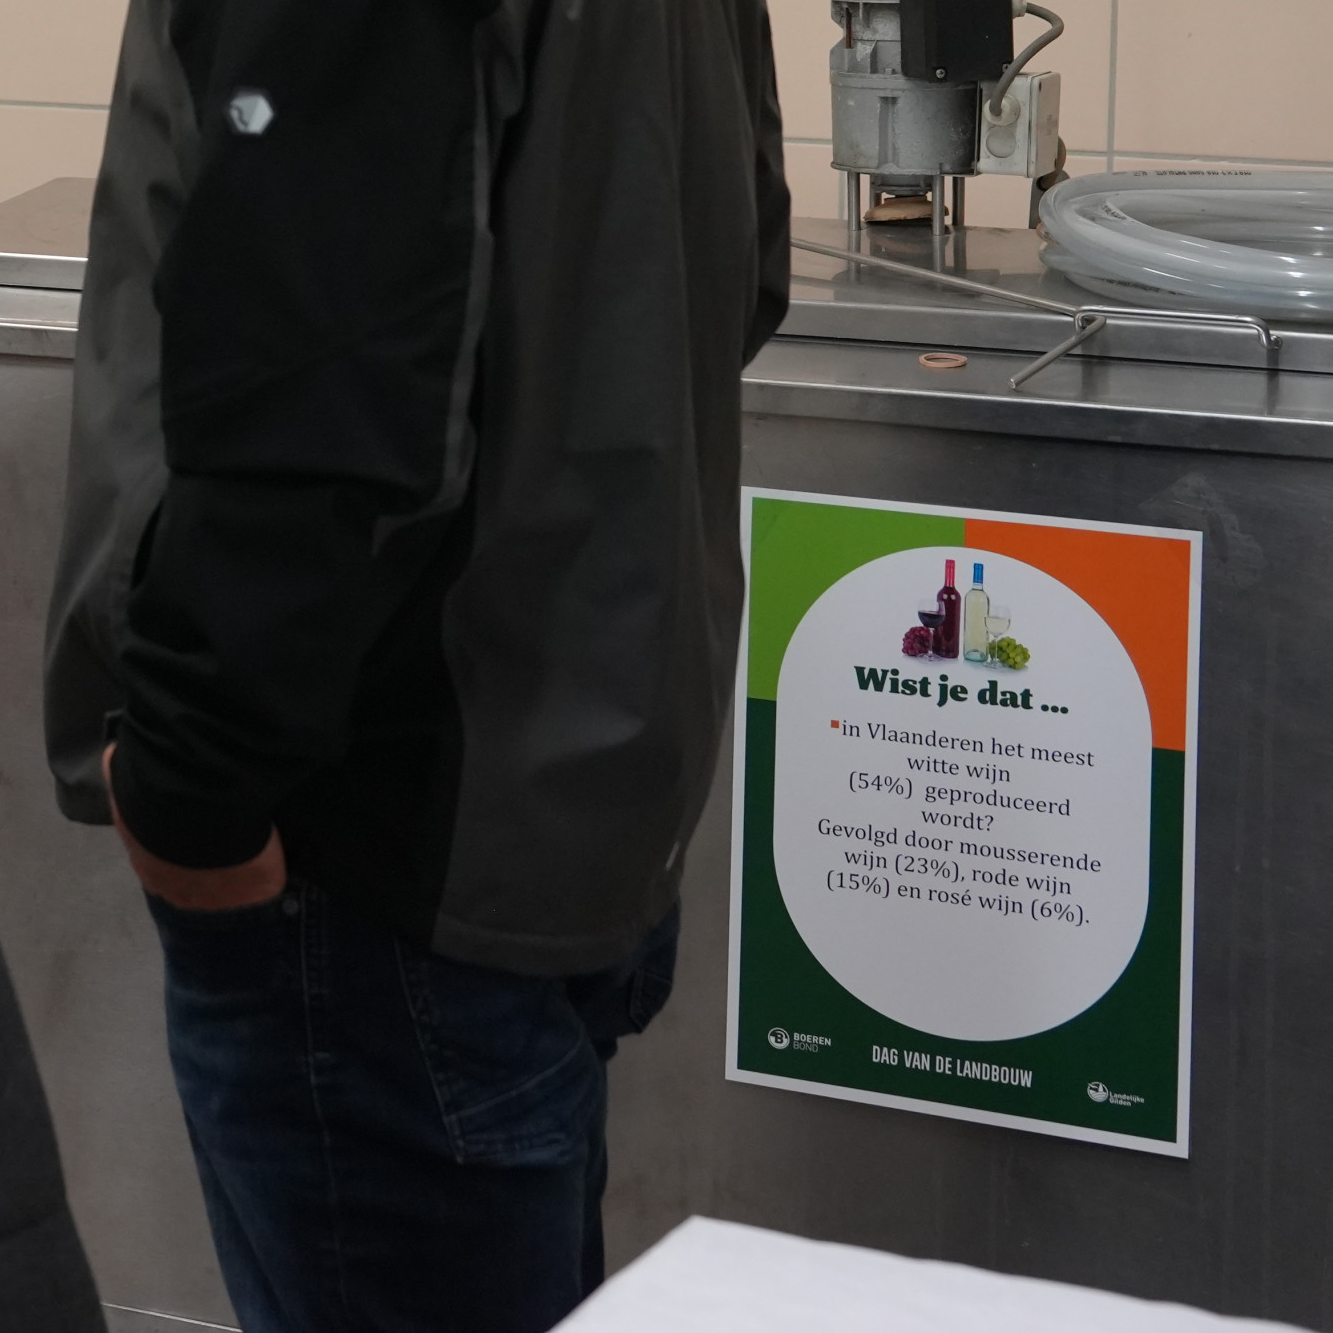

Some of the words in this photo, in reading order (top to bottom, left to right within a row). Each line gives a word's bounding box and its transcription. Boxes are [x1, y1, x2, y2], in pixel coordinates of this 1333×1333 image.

[854, 666, 932, 698] Wist
[936, 674, 969, 707] je
[977, 680, 1033, 709] dat
[842, 720, 860, 737] in
[867, 723, 984, 753] Vlaanderen
[991, 738, 1024, 758] het
[1031, 746, 1094, 766] meest
[907, 756, 959, 775] witte
[966, 764, 1010, 784] wijn
[849, 771, 913, 799] (54%)
[925, 785, 1070, 816] geproduceerd
[921, 810, 994, 831] wordt?
[818, 818, 898, 847] Gevolgd
[905, 830, 953, 852] door
[960, 840, 1101, 872] mousserende
[844, 850, 887, 870] wijn
[895, 854, 965, 883] (23%),
[972, 869, 1019, 887] rode
[1026, 875, 1071, 897] wijn
[827, 870, 890, 899] (15%)
[897, 884, 921, 900] en
[928, 889, 972, 907] rosé
[978, 895, 1023, 916] wijn
[1030, 899, 1090, 927] (6%).
[793, 1032, 831, 1047] BOEREN
[793, 1041, 819, 1053] BOND
[872, 1045, 898, 1066] DAG
[903, 1050, 930, 1071] VAN
[935, 1055, 952, 1075] DE
[957, 1059, 1032, 1088] LANDBOUW
[1109, 1091, 1145, 1103] Landelijke
[1109, 1098, 1131, 1107] Gilden
